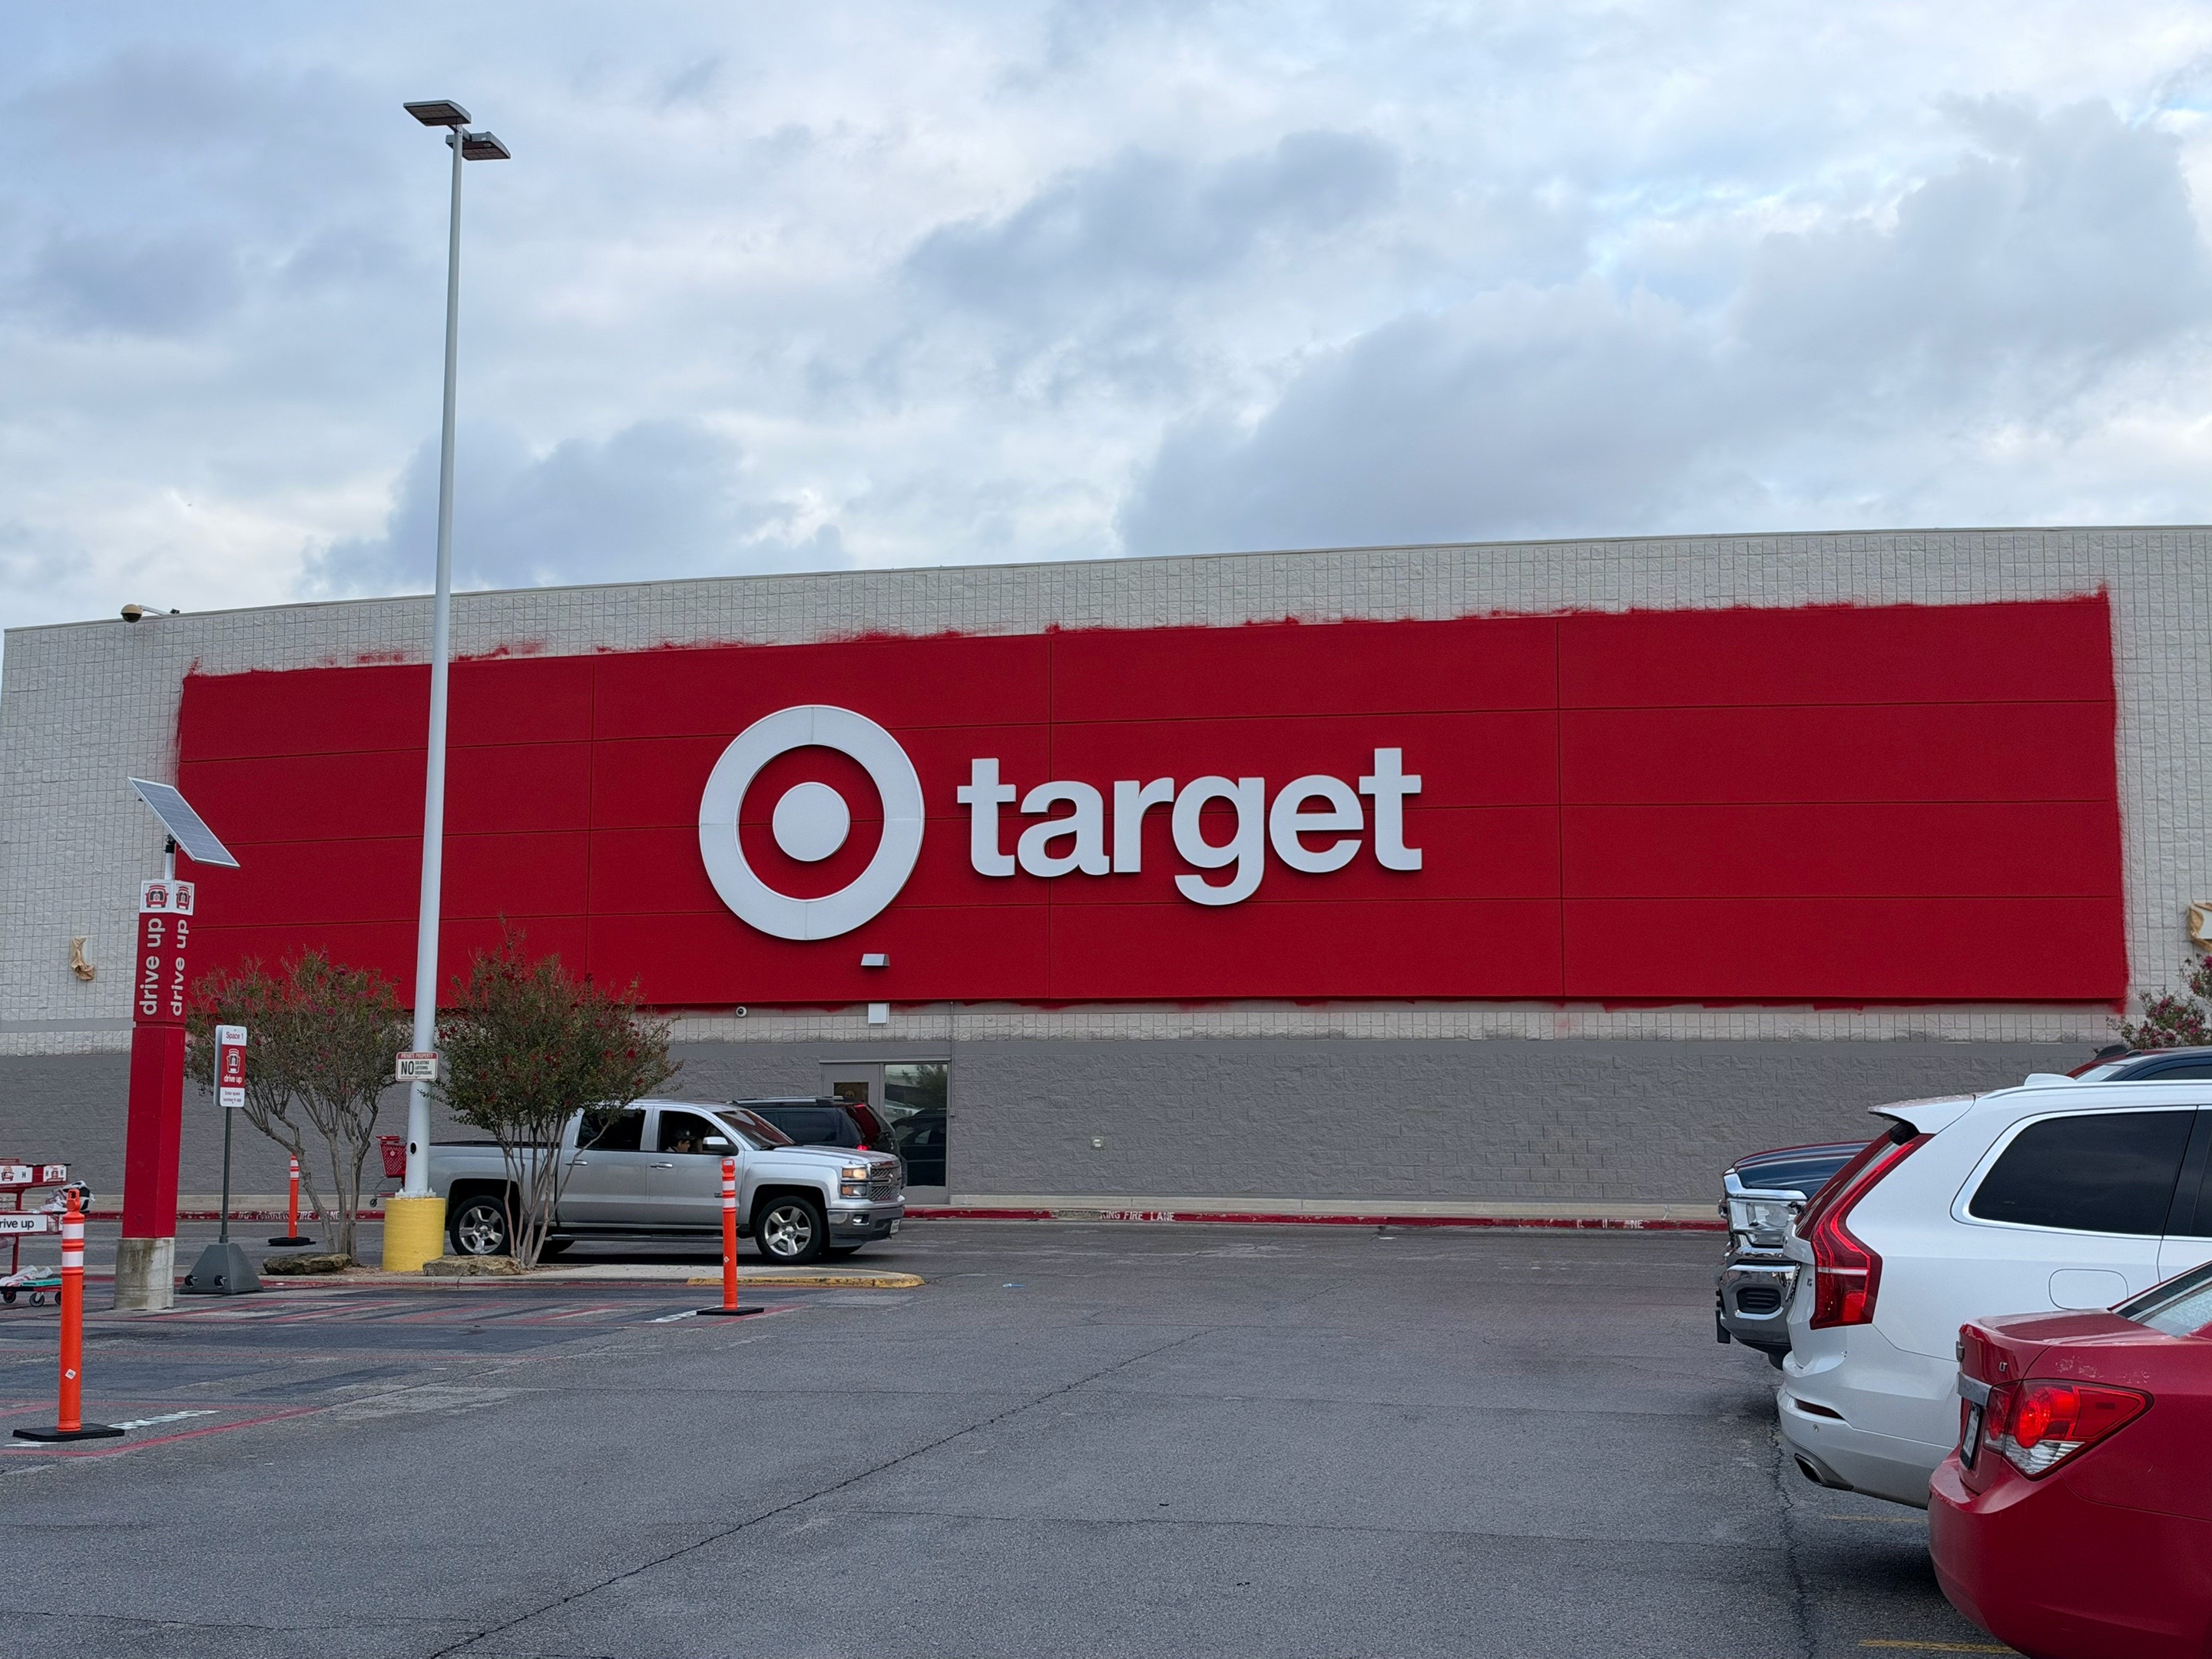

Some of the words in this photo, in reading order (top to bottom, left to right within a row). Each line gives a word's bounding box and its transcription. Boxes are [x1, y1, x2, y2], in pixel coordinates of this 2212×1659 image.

[957, 747, 1422, 906] target
[147, 918, 166, 948] up
[177, 919, 190, 949] up
[139, 955, 161, 1016] drive
[171, 957, 186, 1017] drive
[226, 1031, 240, 1040] Space
[401, 1061, 415, 1075] NO
[224, 1074, 236, 1083] drive
[1123, 1211, 1144, 1220] FIRE
[1150, 1211, 1177, 1221] LANE
[0, 1218, 18, 1228] rive
[21, 1219, 35, 1230] up
[1998, 1362, 2008, 1372] LT
